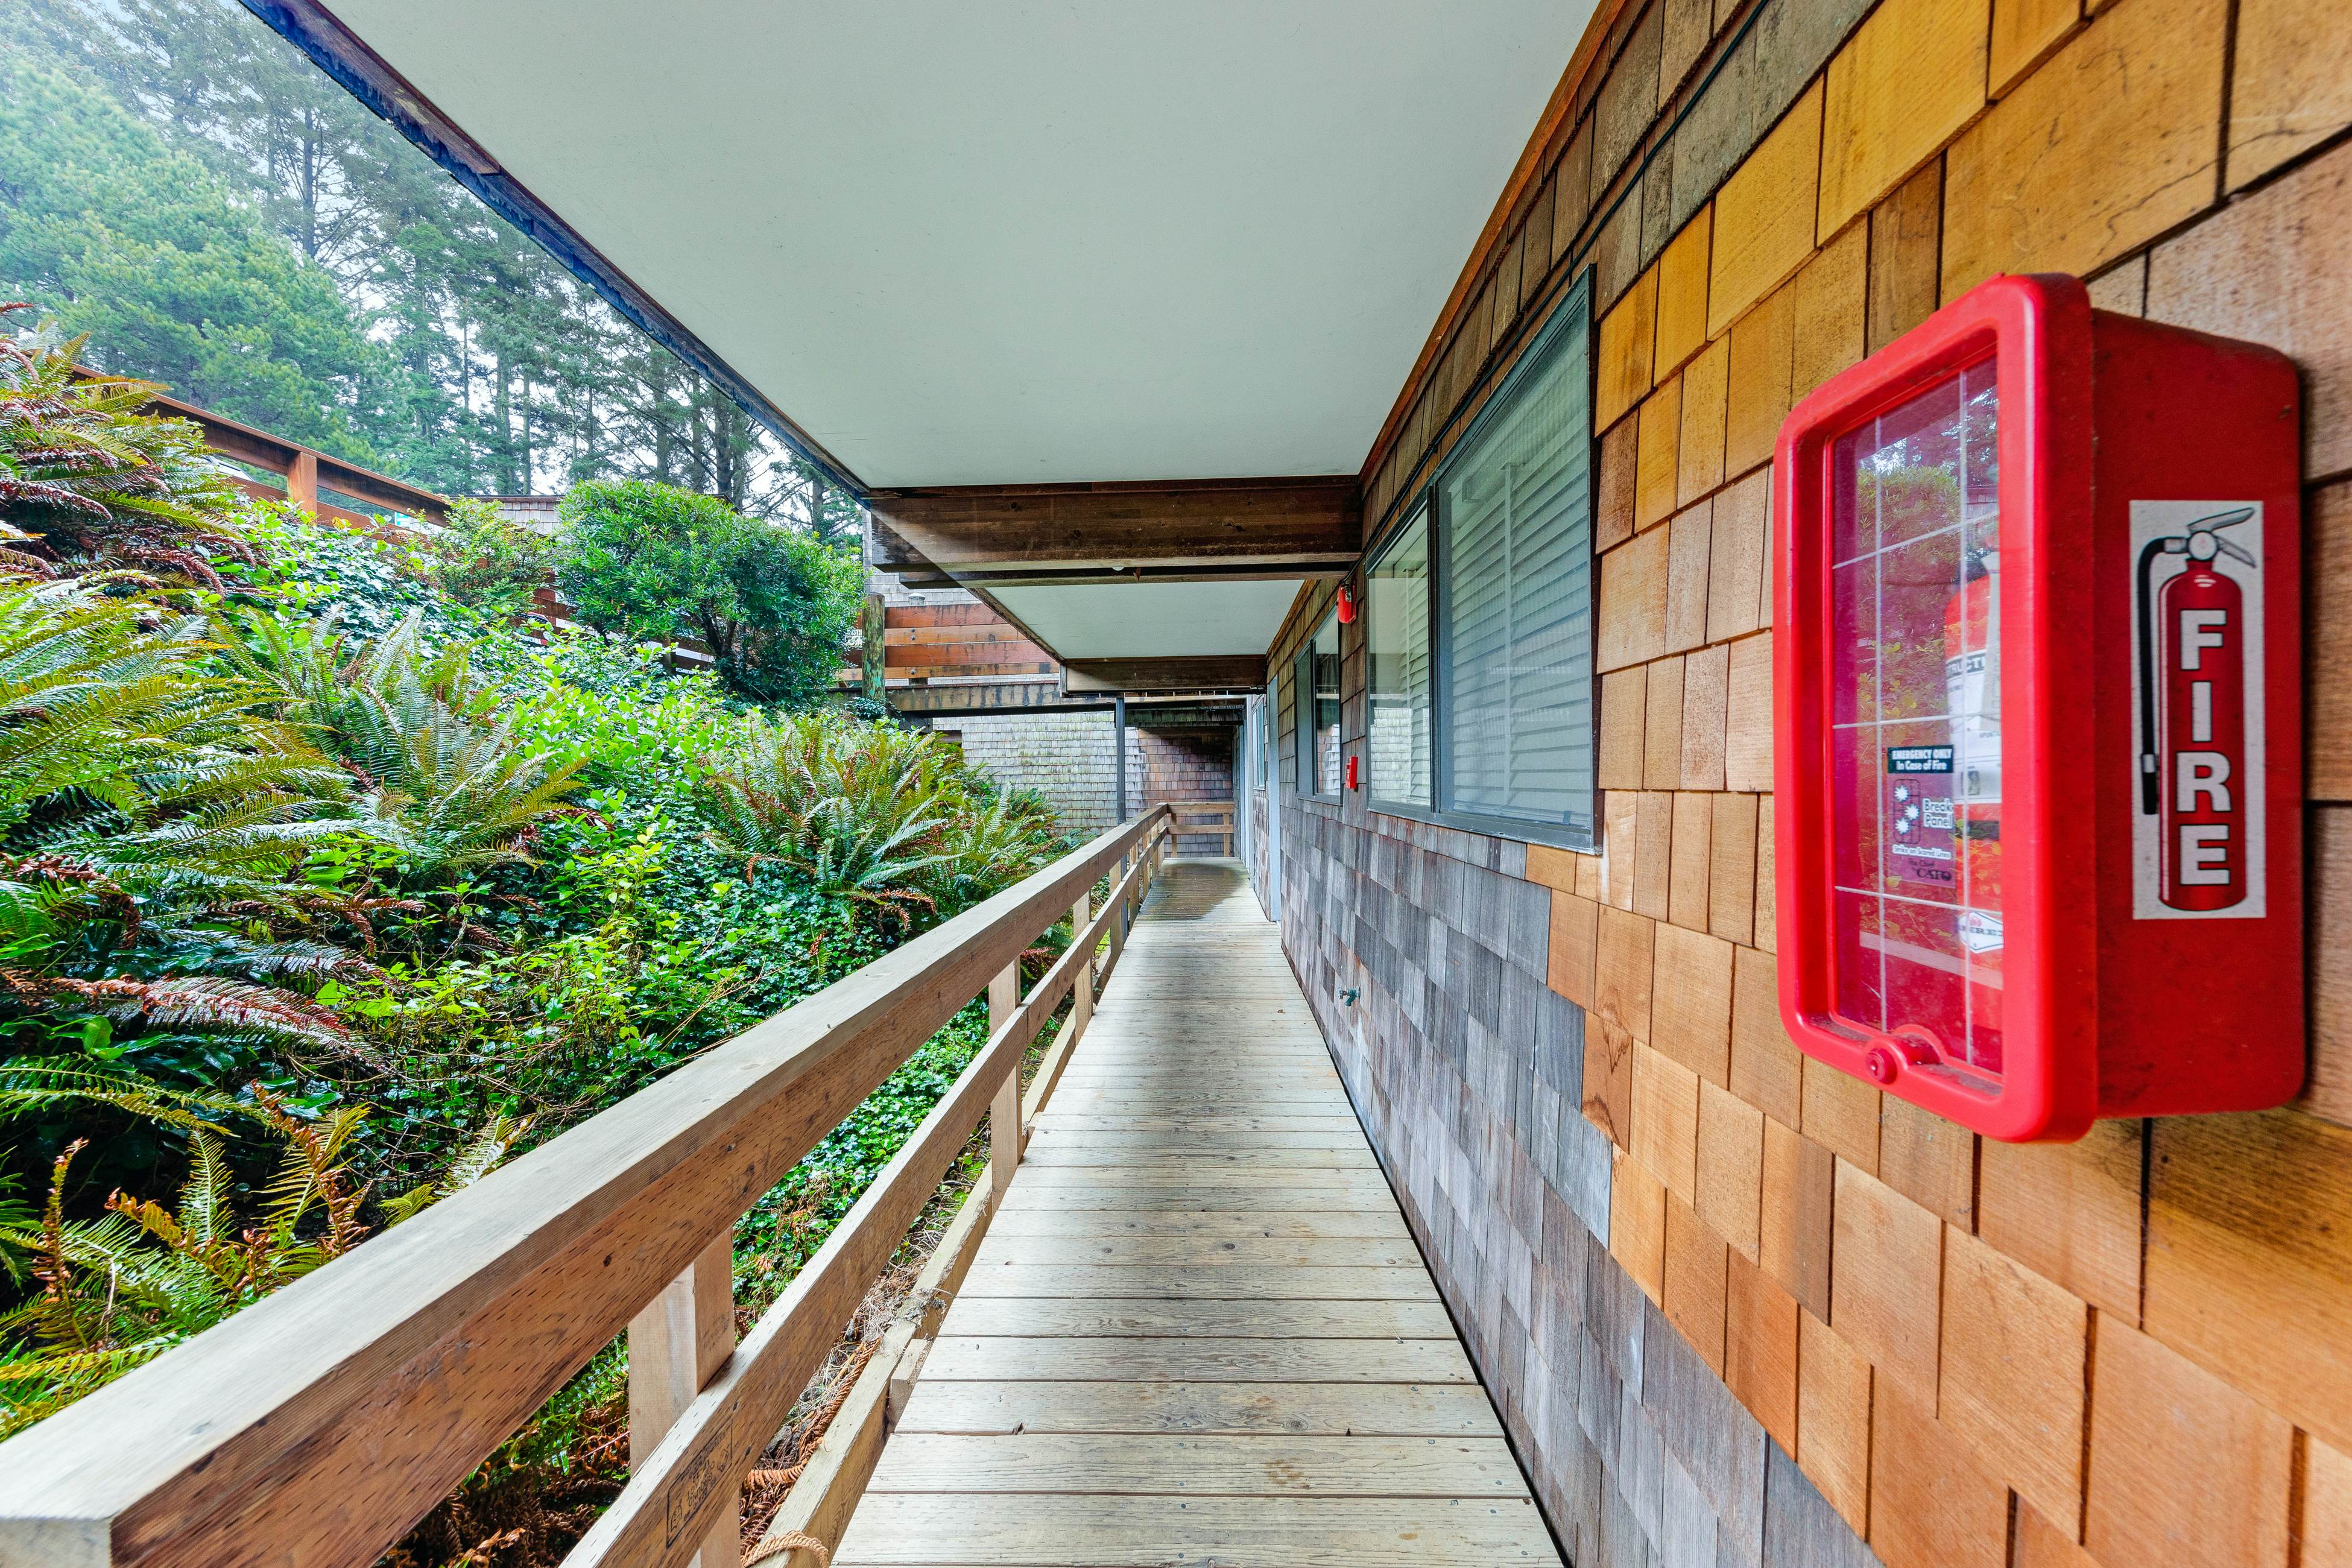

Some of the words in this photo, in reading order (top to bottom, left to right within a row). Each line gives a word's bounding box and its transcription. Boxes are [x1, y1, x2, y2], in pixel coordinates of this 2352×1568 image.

[2175, 609, 2232, 885] FIRE
[1892, 750, 1932, 760] EMERGENCY
[1932, 749, 1952, 759] ONLY
[1896, 760, 1905, 770] In
[1905, 760, 1922, 770] Case
[1923, 759, 1931, 770] of
[1932, 759, 1947, 770] Fire
[1923, 799, 1952, 812] Break
[1924, 814, 1953, 828] Panel
